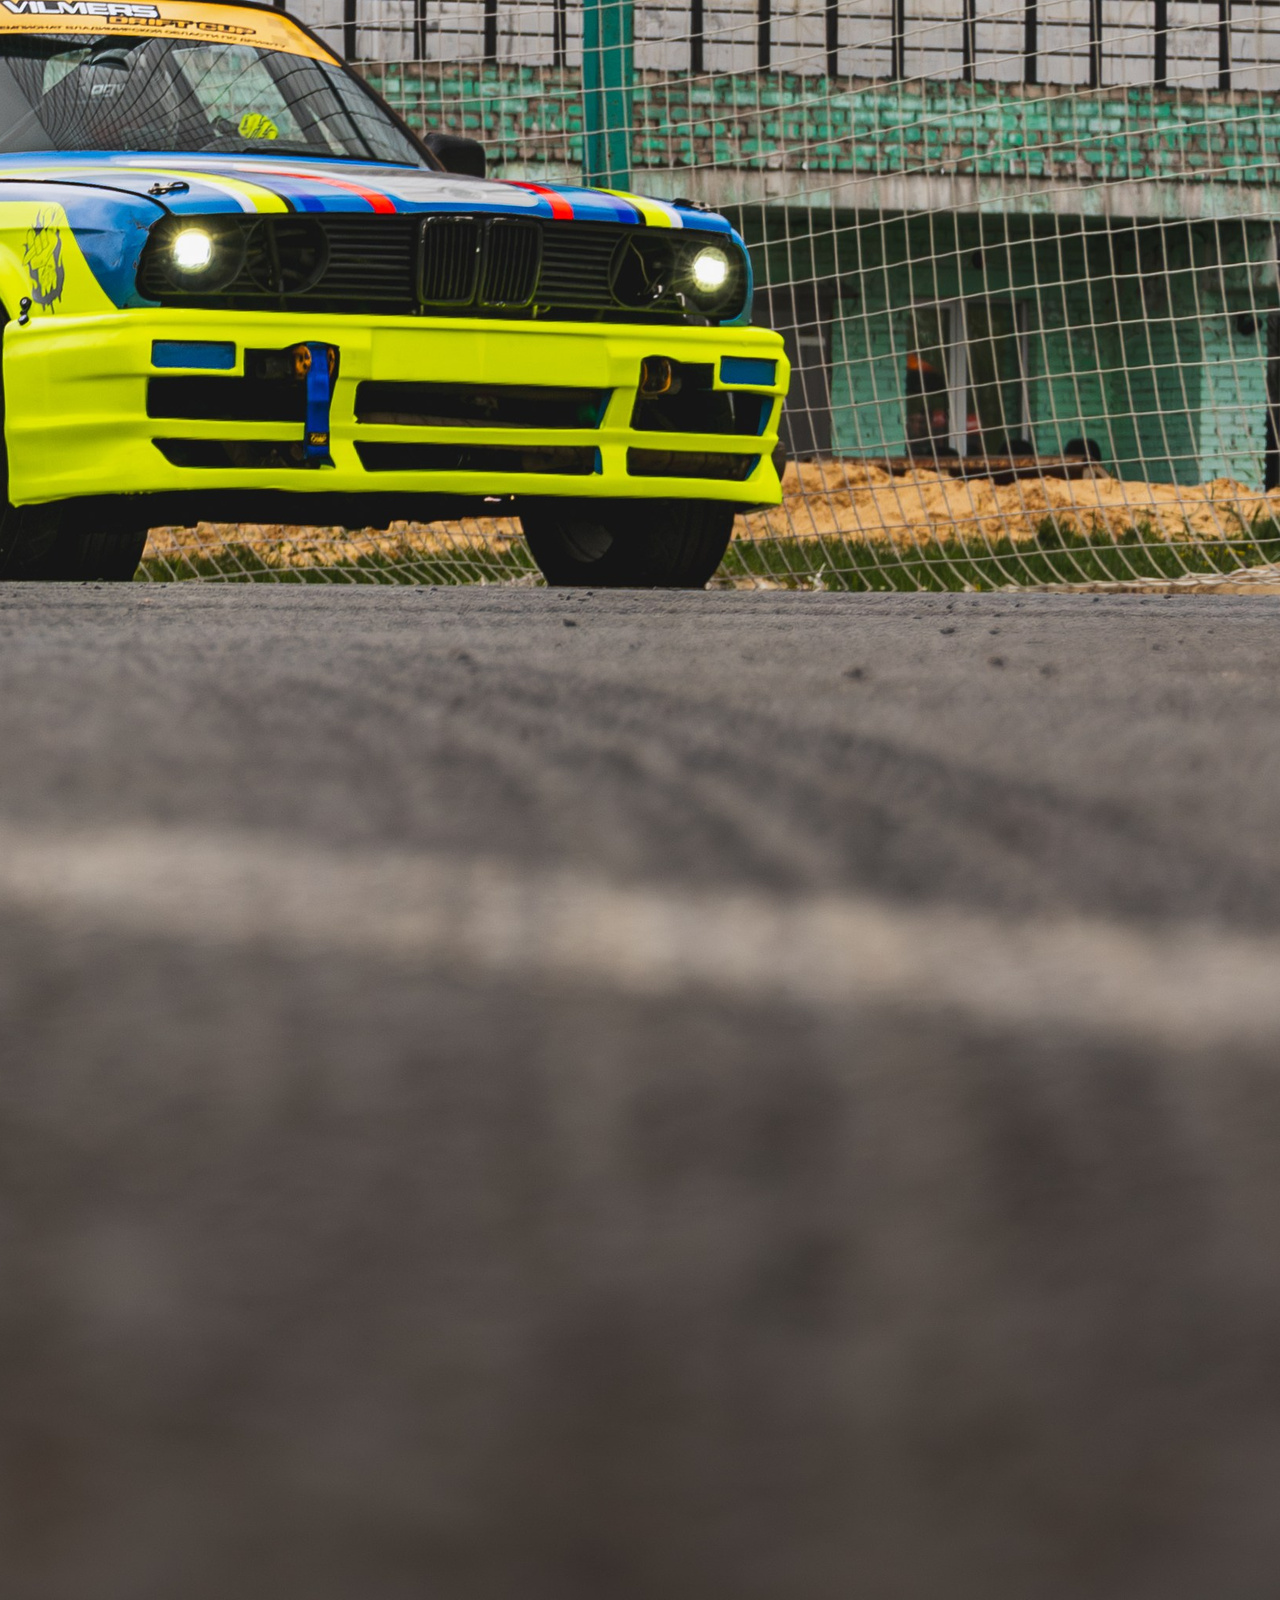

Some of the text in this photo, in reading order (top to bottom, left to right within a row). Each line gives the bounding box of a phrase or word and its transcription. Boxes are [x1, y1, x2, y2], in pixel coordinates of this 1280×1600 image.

[1, 0, 159, 18] VILMERS
[106, 16, 257, 35] DRIFT CUP
